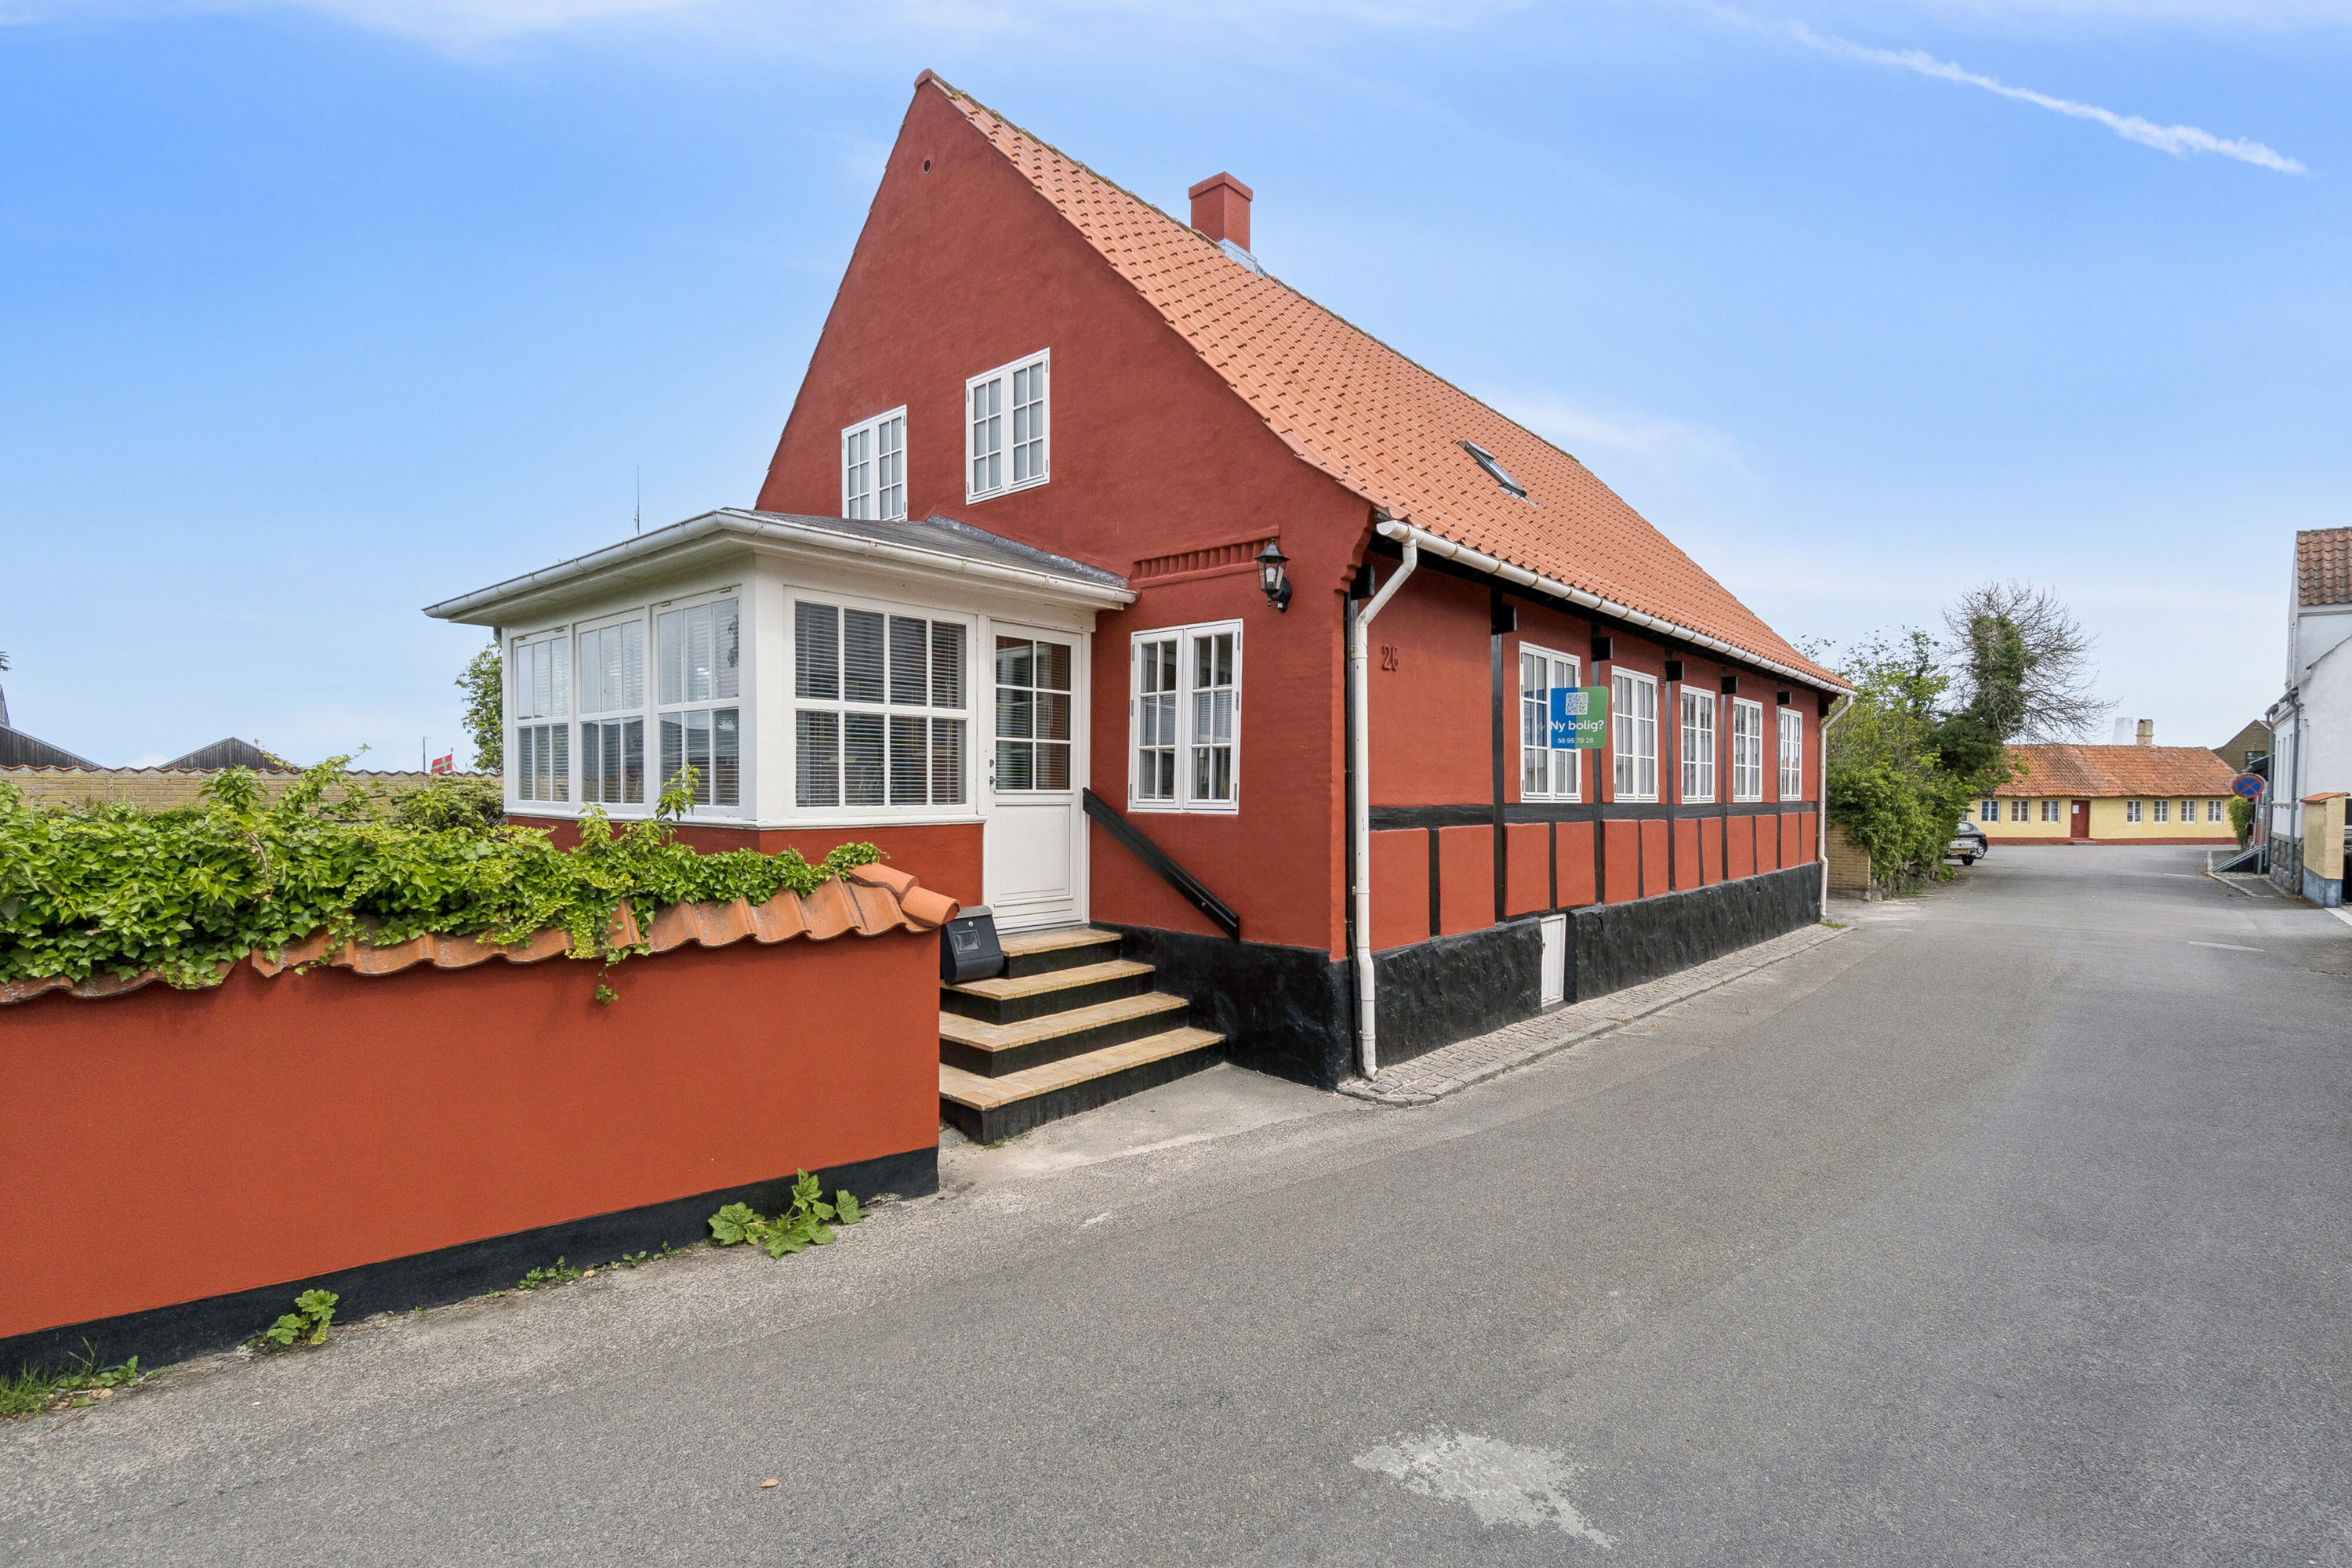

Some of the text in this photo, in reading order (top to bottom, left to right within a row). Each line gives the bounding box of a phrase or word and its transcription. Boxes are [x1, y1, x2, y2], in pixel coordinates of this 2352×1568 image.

[1381, 644, 1399, 671] 26
[1551, 720, 1604, 732] Ny bolig?
